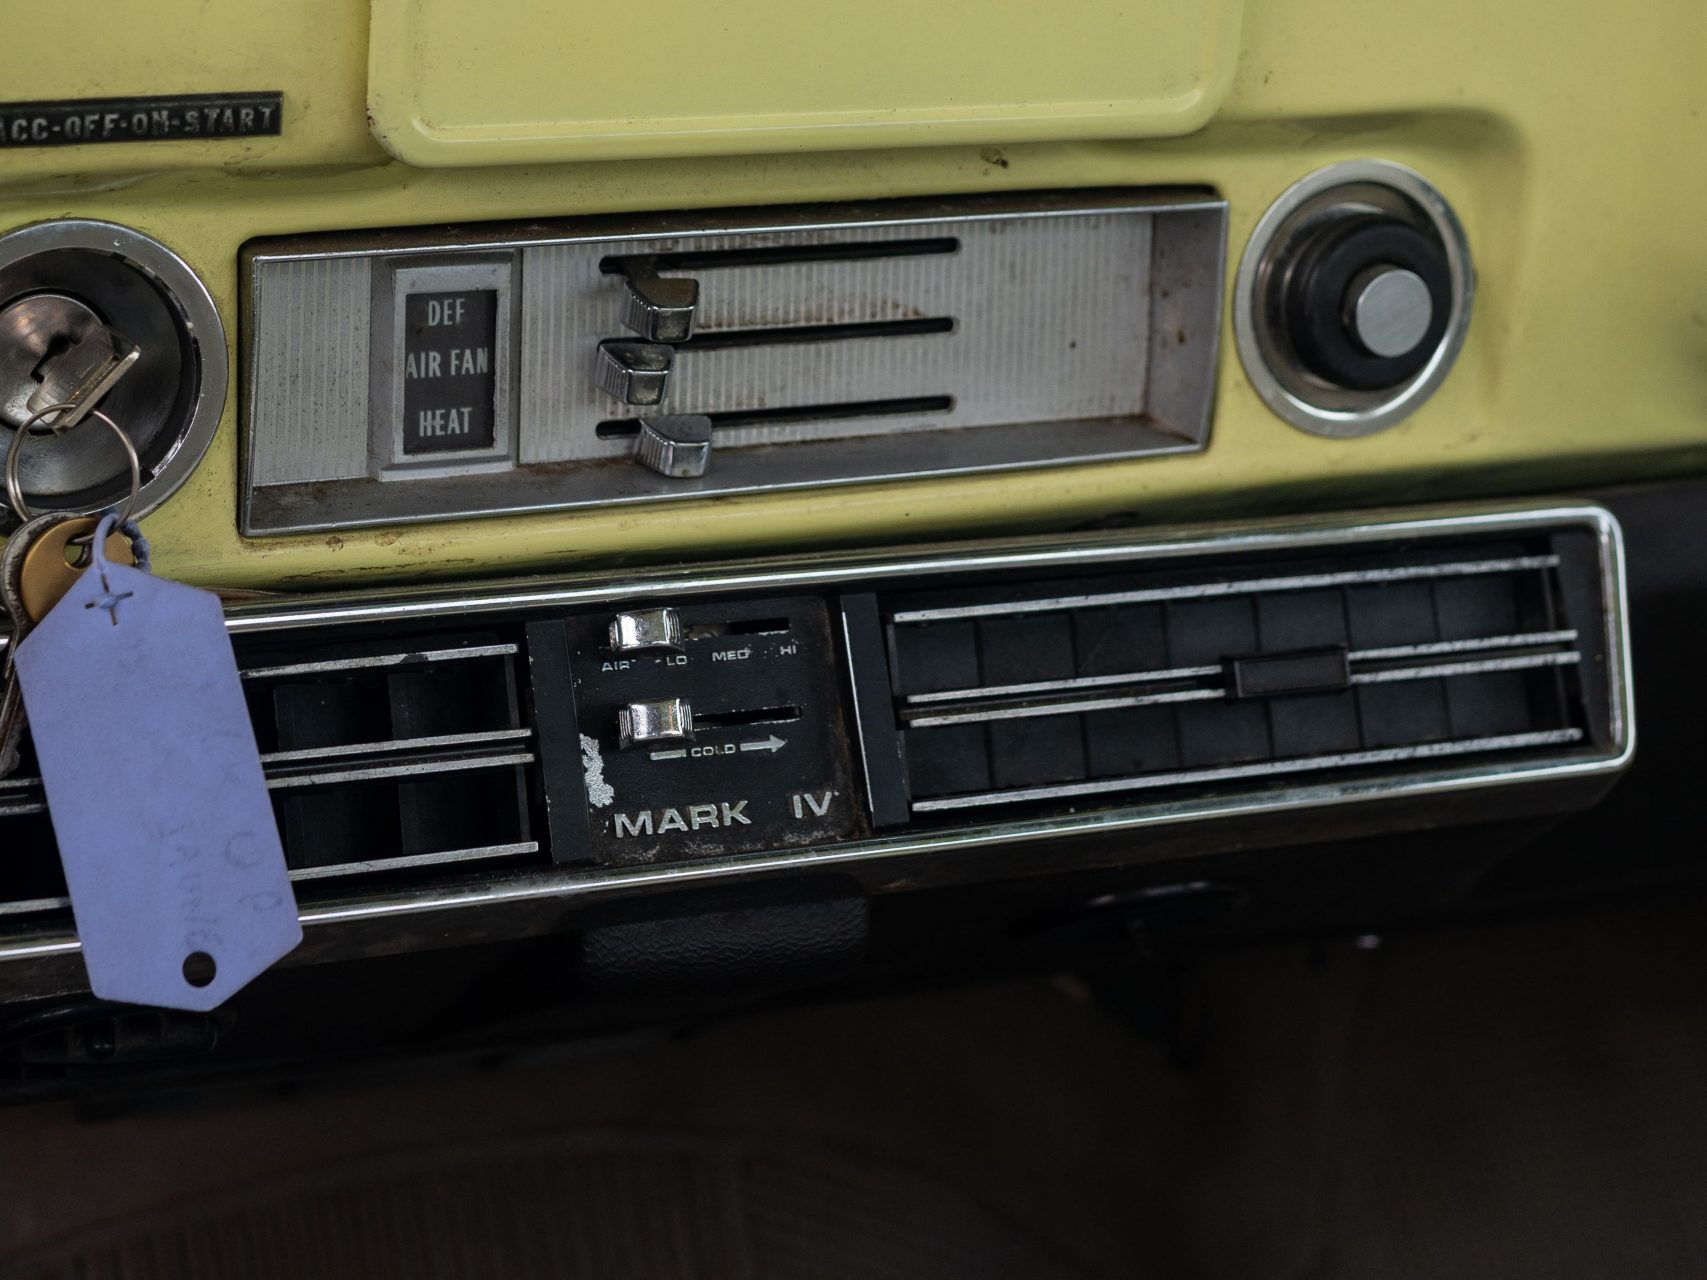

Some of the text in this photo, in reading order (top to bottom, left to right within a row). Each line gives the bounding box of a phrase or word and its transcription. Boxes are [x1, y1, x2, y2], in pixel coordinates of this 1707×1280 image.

[428, 298, 466, 327] DEF
[406, 347, 489, 379] AIR FAN
[419, 407, 473, 437] HEAT
[601, 645, 797, 671] AIR LO MED HI
[690, 744, 737, 758] COLD
[614, 791, 833, 839] MARK IV
